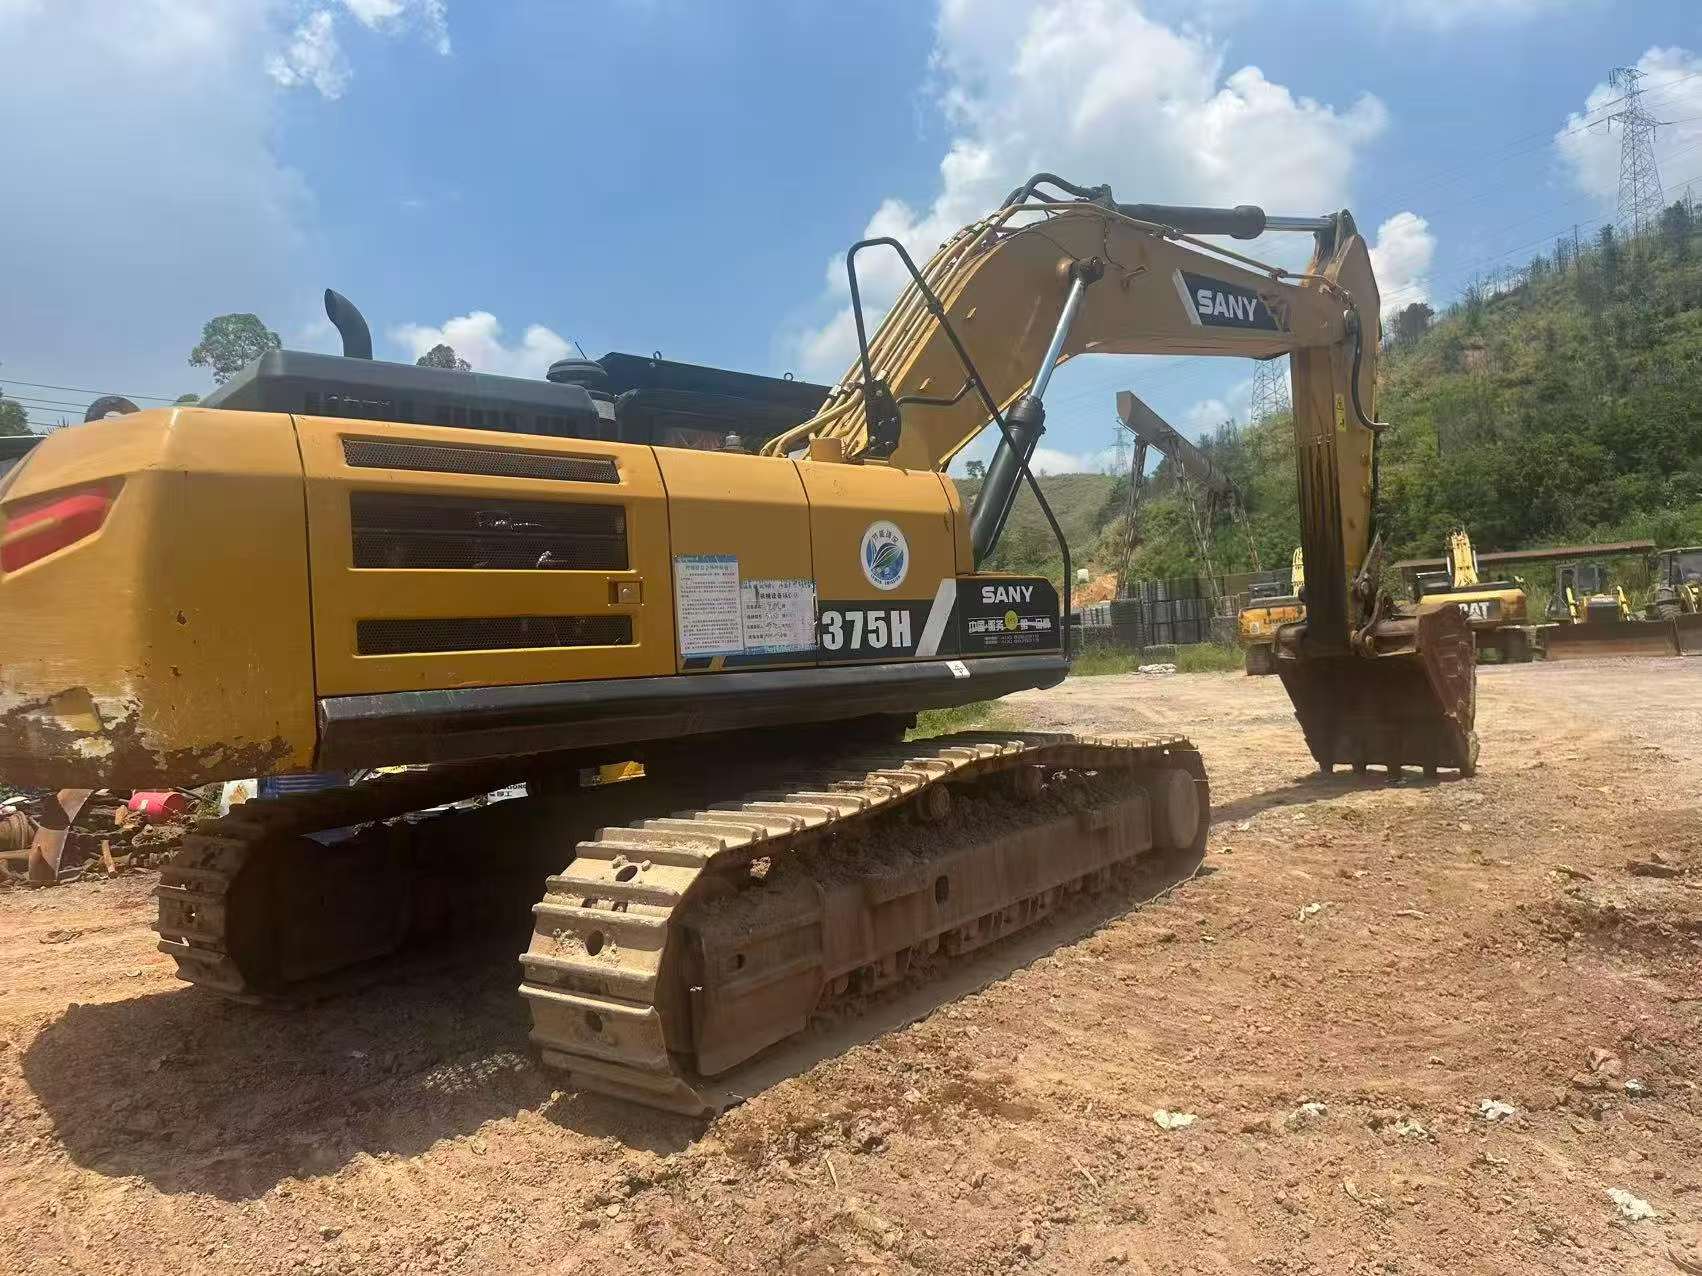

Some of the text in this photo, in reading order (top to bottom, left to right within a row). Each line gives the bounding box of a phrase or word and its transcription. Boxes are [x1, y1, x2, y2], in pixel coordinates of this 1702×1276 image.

[1196, 288, 1258, 322] SANY
[981, 585, 1034, 604] SANY
[821, 610, 912, 651] 375H
